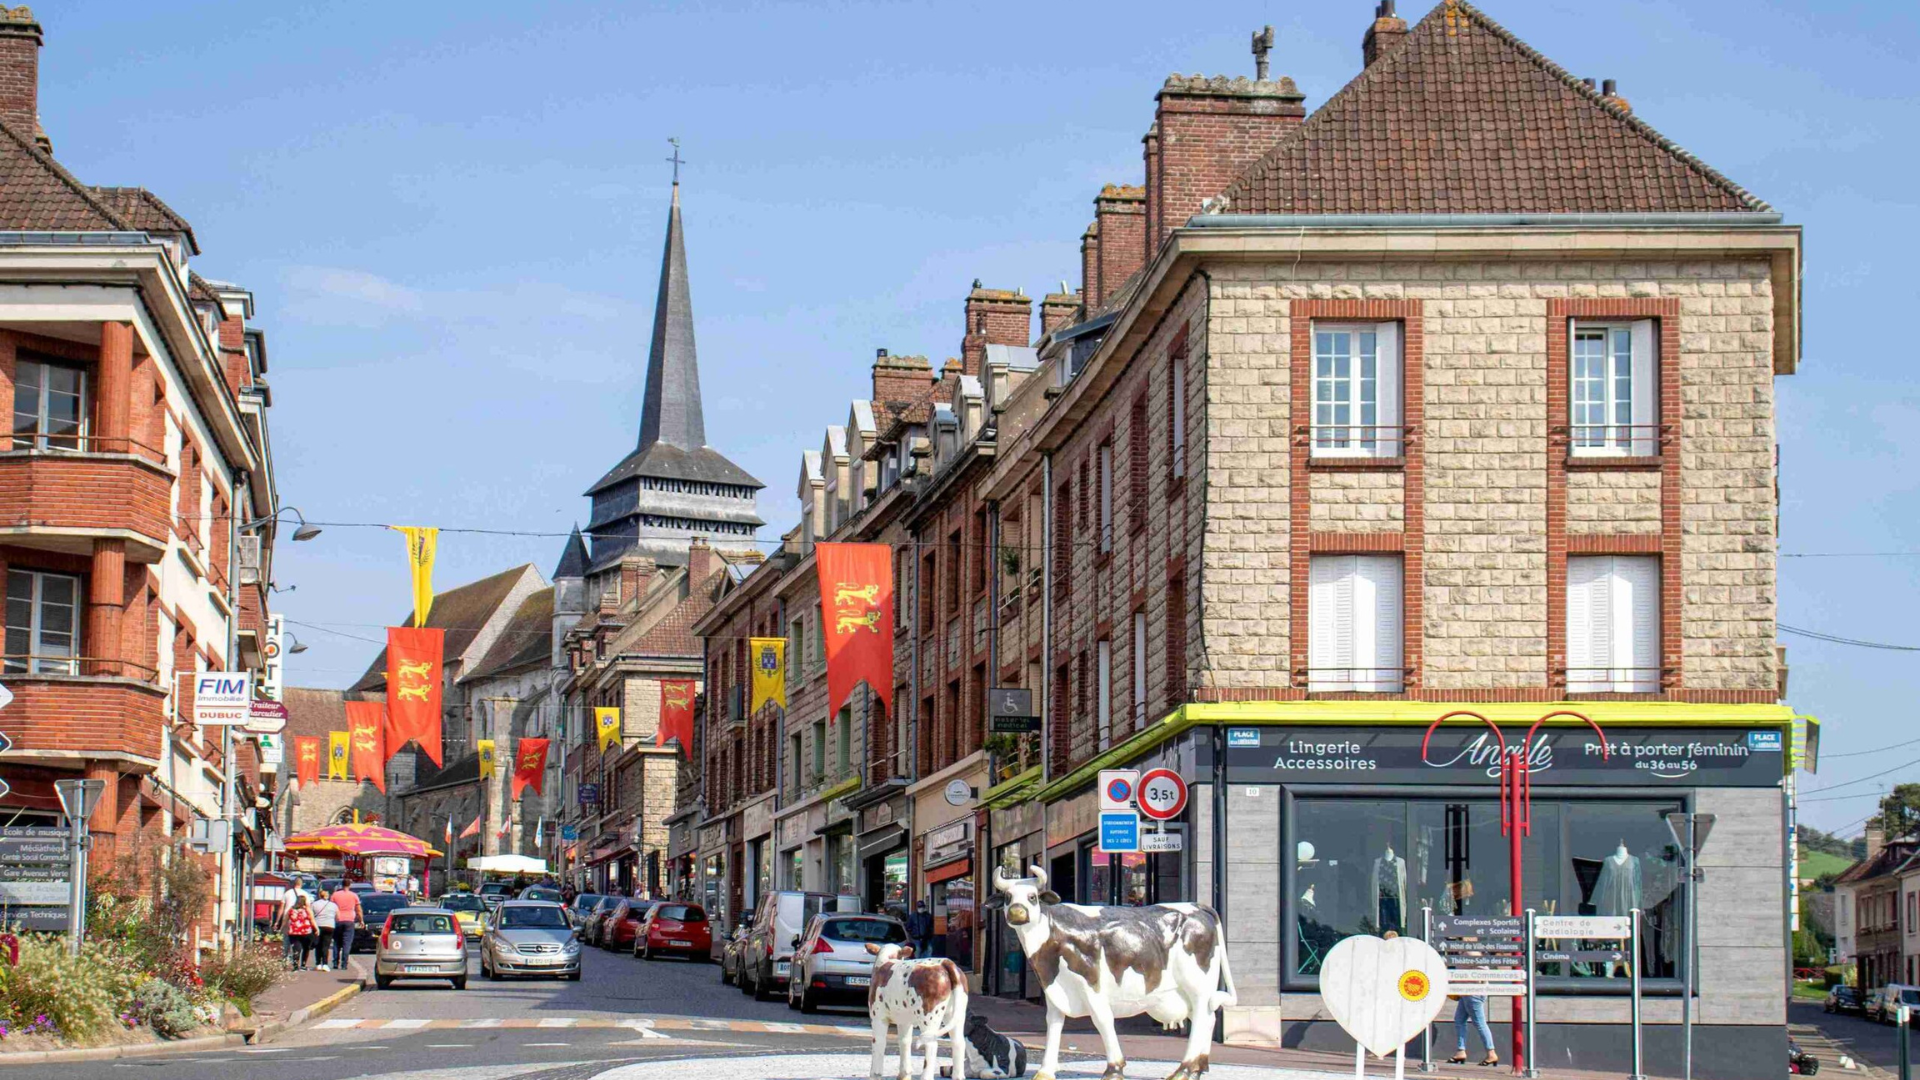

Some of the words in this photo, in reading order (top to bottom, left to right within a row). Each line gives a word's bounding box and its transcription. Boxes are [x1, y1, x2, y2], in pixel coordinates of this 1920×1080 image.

[198, 678, 245, 694] FIM
[199, 711, 243, 719] DUBUC
[250, 710, 283, 718] harcutier
[1754, 733, 1775, 741] PLACE
[1289, 741, 1360, 756] Lingerie
[1584, 742, 1617, 756] Prêt
[1620, 742, 1631, 756] à
[1635, 744, 1682, 758] porter
[1687, 742, 1749, 758] féminin
[1273, 756, 1377, 770] Accessoires
[1635, 761, 1649, 769] du
[1650, 760, 1665, 770] 36
[1682, 760, 1697, 770] 56
[26, 828, 35, 836] de
[38, 829, 70, 838] musique
[20, 844, 64, 853] Médiathèq
[1, 853, 21, 861] Centre
[22, 853, 38, 861] Social
[30, 911, 67, 919] Techniques
[1453, 918, 1491, 927] Complexes
[1493, 918, 1520, 927] Sportifs
[1543, 919, 1574, 927] Centre
[1580, 919, 1591, 927] de
[1542, 928, 1595, 936] Radiologie
[1542, 952, 1570, 960] Cinéma
[1491, 957, 1502, 965] des
[1503, 956, 1519, 965] Fêtes
[1450, 971, 1469, 979] Tous
[1470, 971, 1519, 979] Commerces
